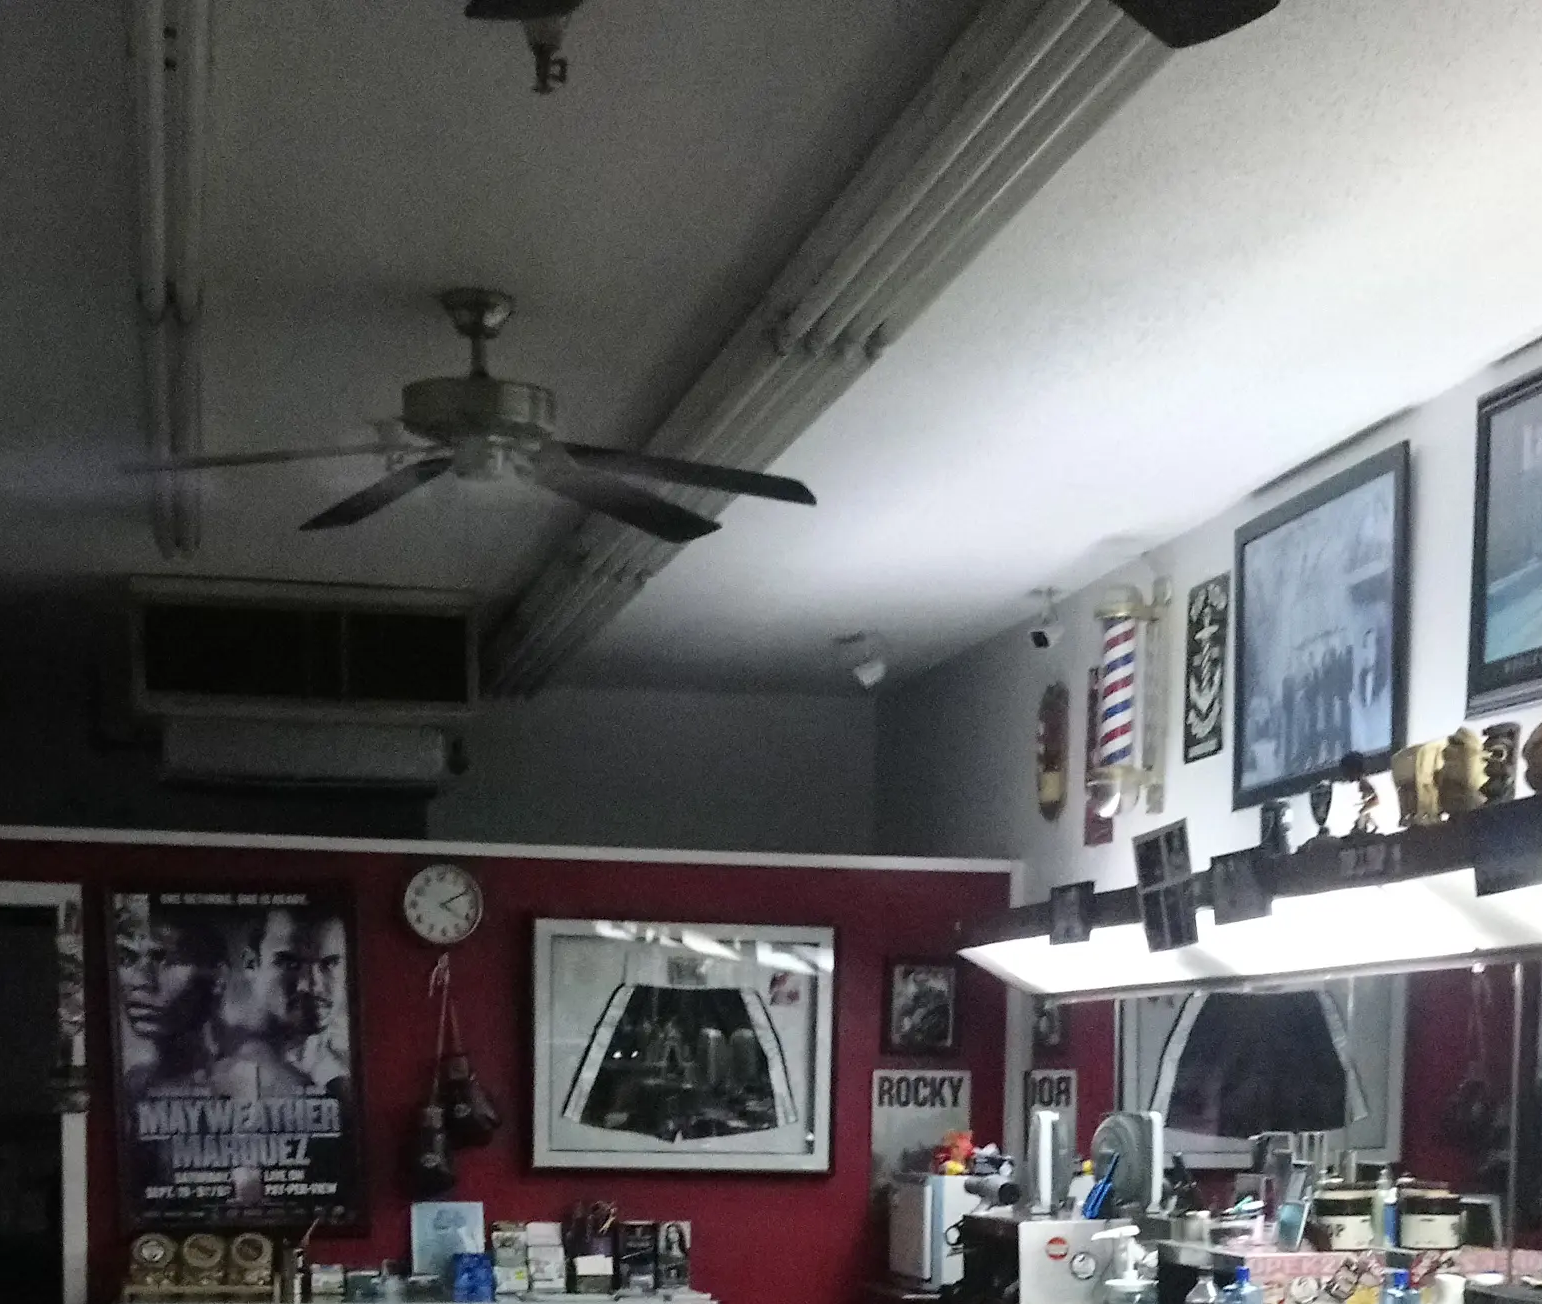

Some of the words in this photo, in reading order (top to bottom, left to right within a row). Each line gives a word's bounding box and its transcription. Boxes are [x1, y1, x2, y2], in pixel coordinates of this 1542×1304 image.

[877, 1075, 964, 1108] ROCKY
[136, 1096, 342, 1136] MAYWEATHER
[171, 1133, 313, 1169] MARQUEZ
